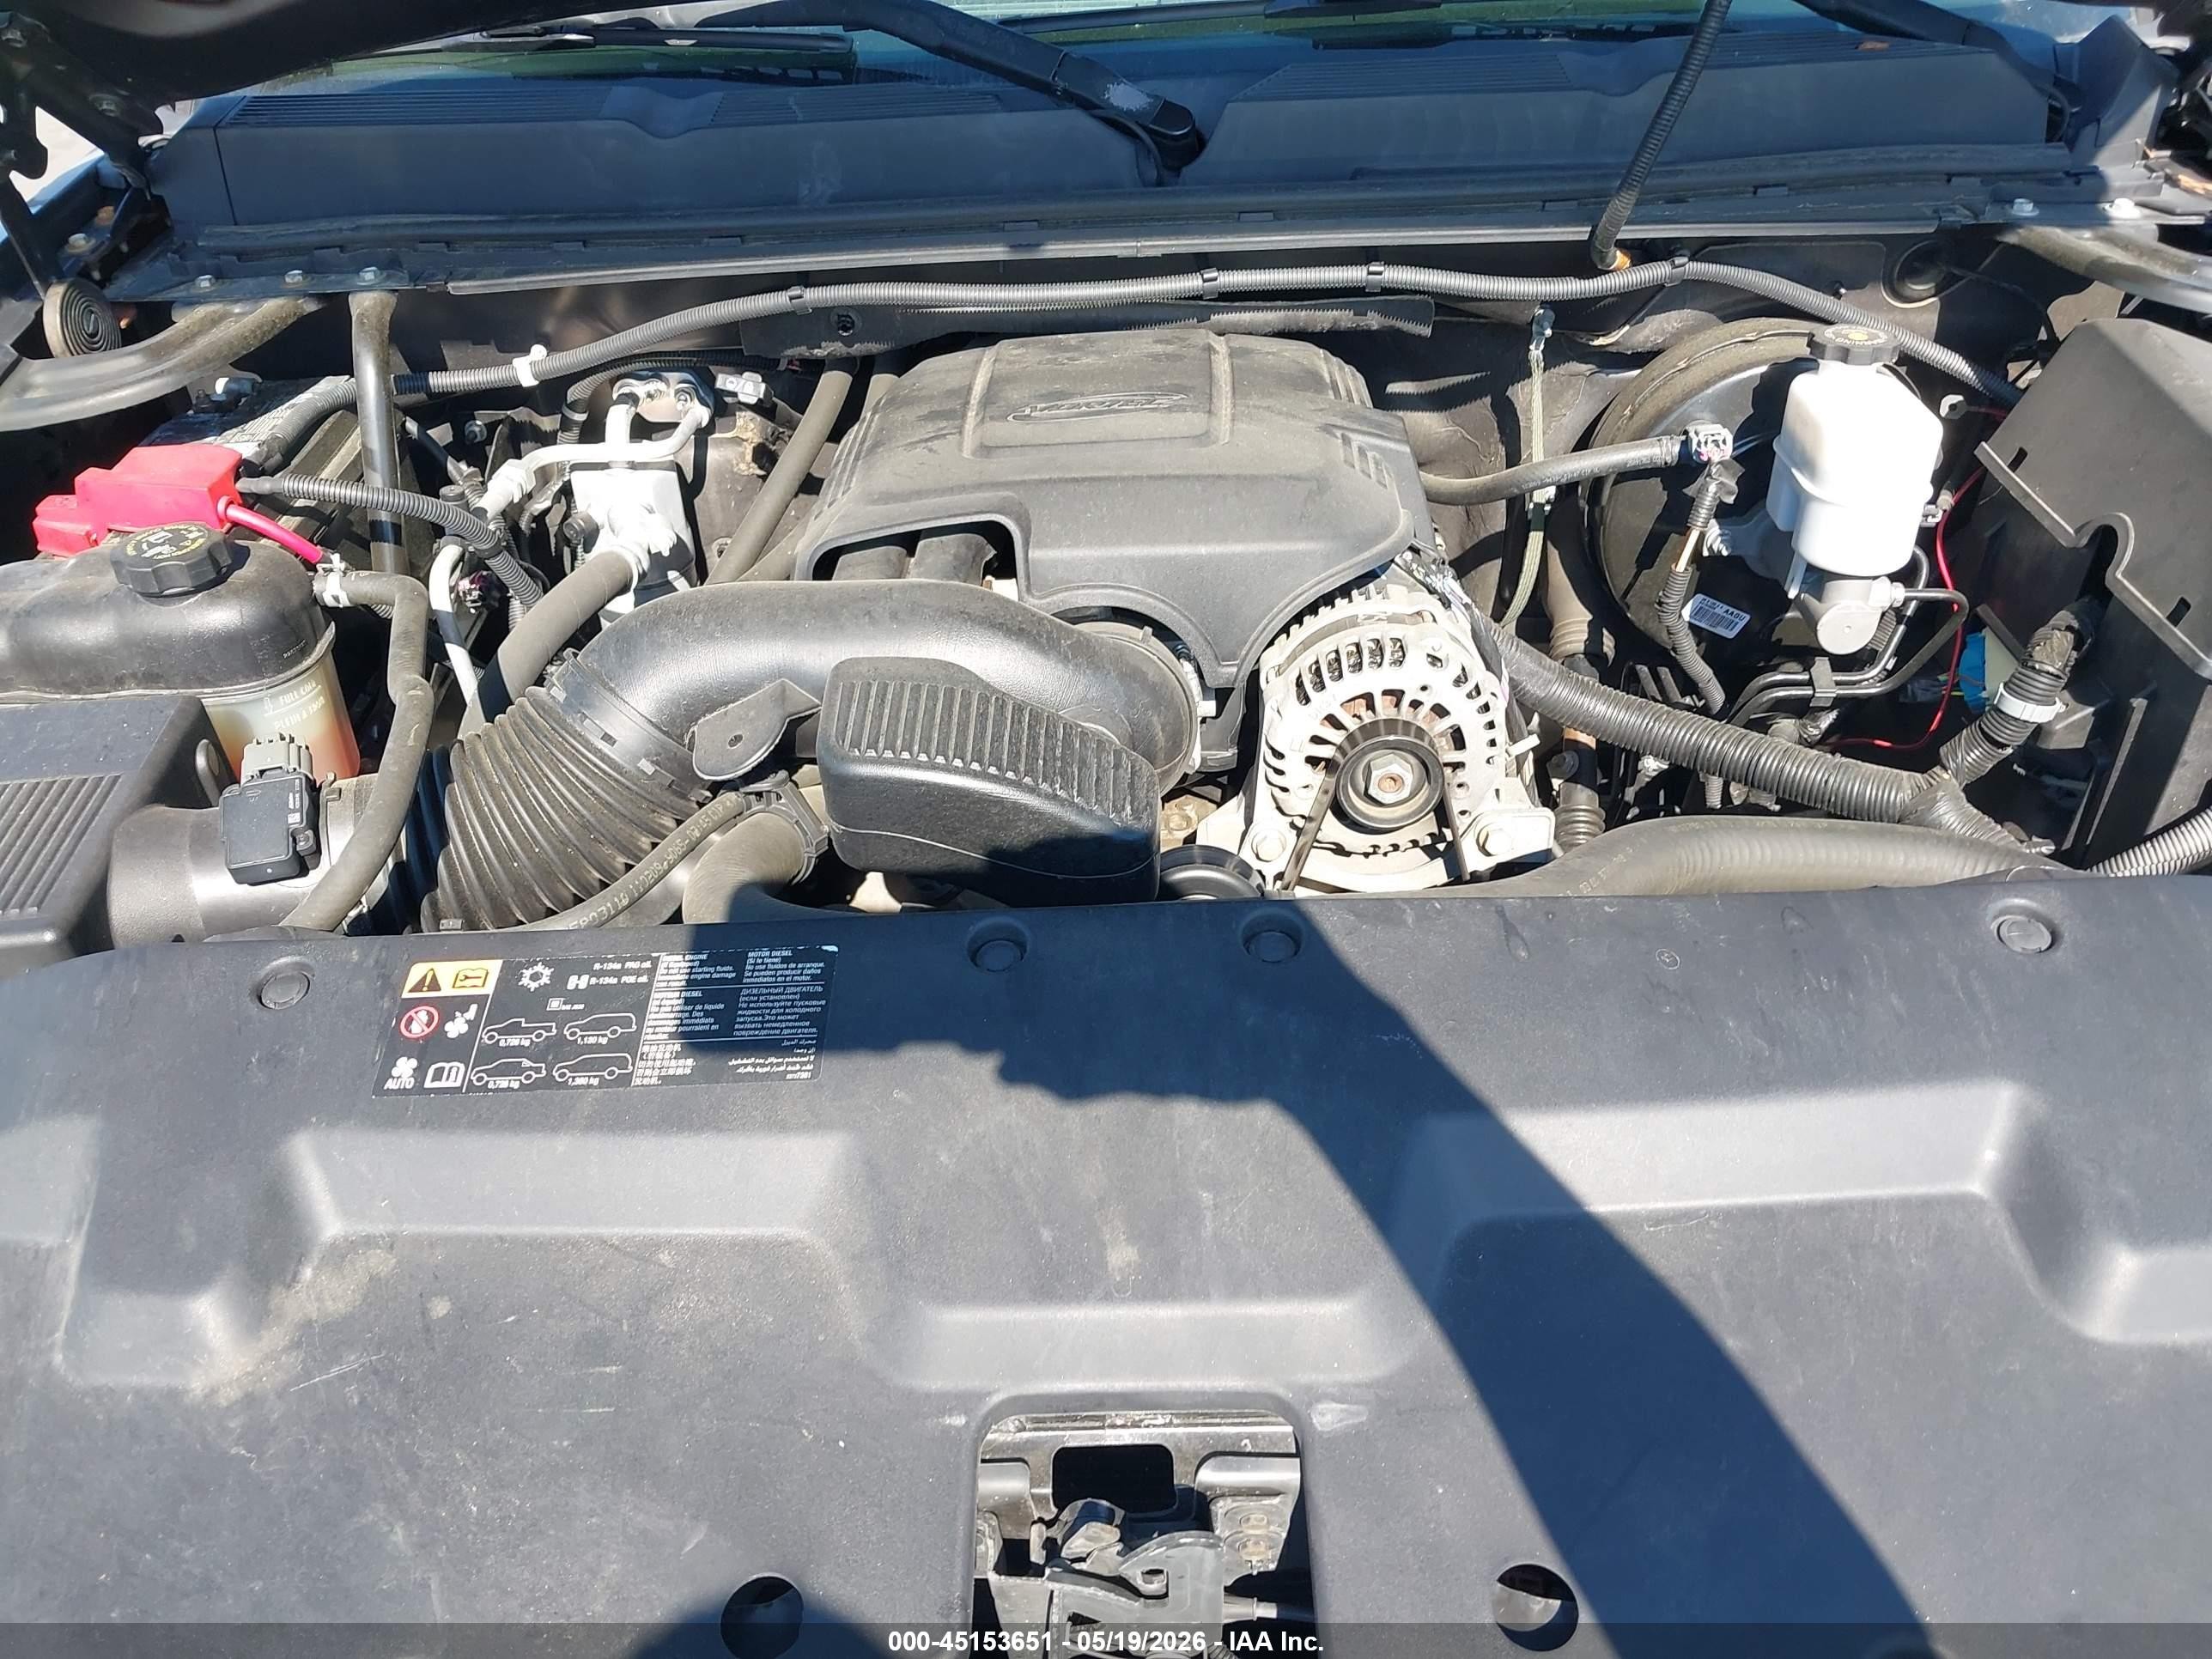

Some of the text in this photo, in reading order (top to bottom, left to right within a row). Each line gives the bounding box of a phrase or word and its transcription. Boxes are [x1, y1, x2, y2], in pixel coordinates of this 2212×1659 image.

[589, 977, 618, 986] R-134a
[620, 975, 636, 984] POE
[740, 985, 823, 995] ДИЗЕЛЬНЫЙ ДВИГАТЕЛЬ
[759, 993, 800, 1002] установлен)
[678, 1024, 710, 1033] pourraient
[384, 1077, 416, 1091] AUTO
